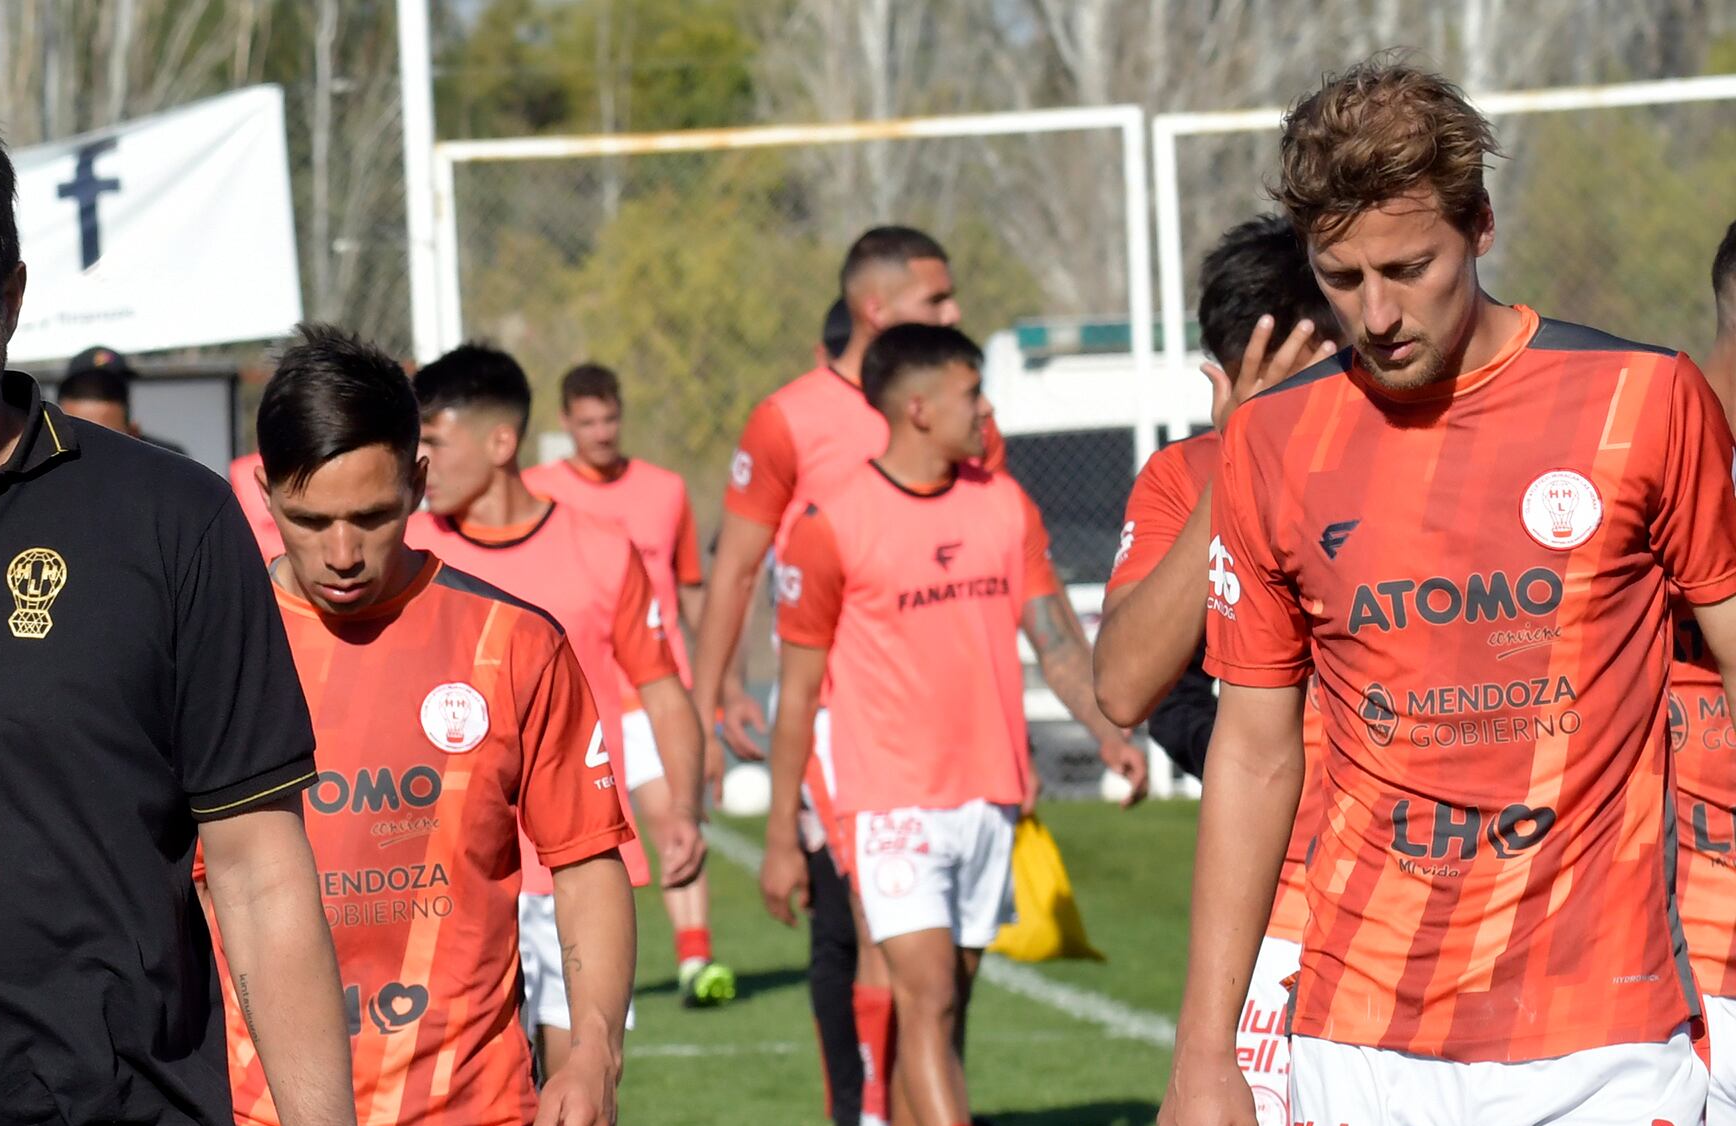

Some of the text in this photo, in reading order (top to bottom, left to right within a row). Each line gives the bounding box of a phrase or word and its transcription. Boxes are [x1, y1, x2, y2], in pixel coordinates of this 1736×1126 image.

[1346, 565, 1564, 636] ATOMO
[1406, 675, 1578, 718] MENDOZA
[1408, 709, 1583, 749] GOBIERNO
[318, 863, 450, 899] ENDOZA
